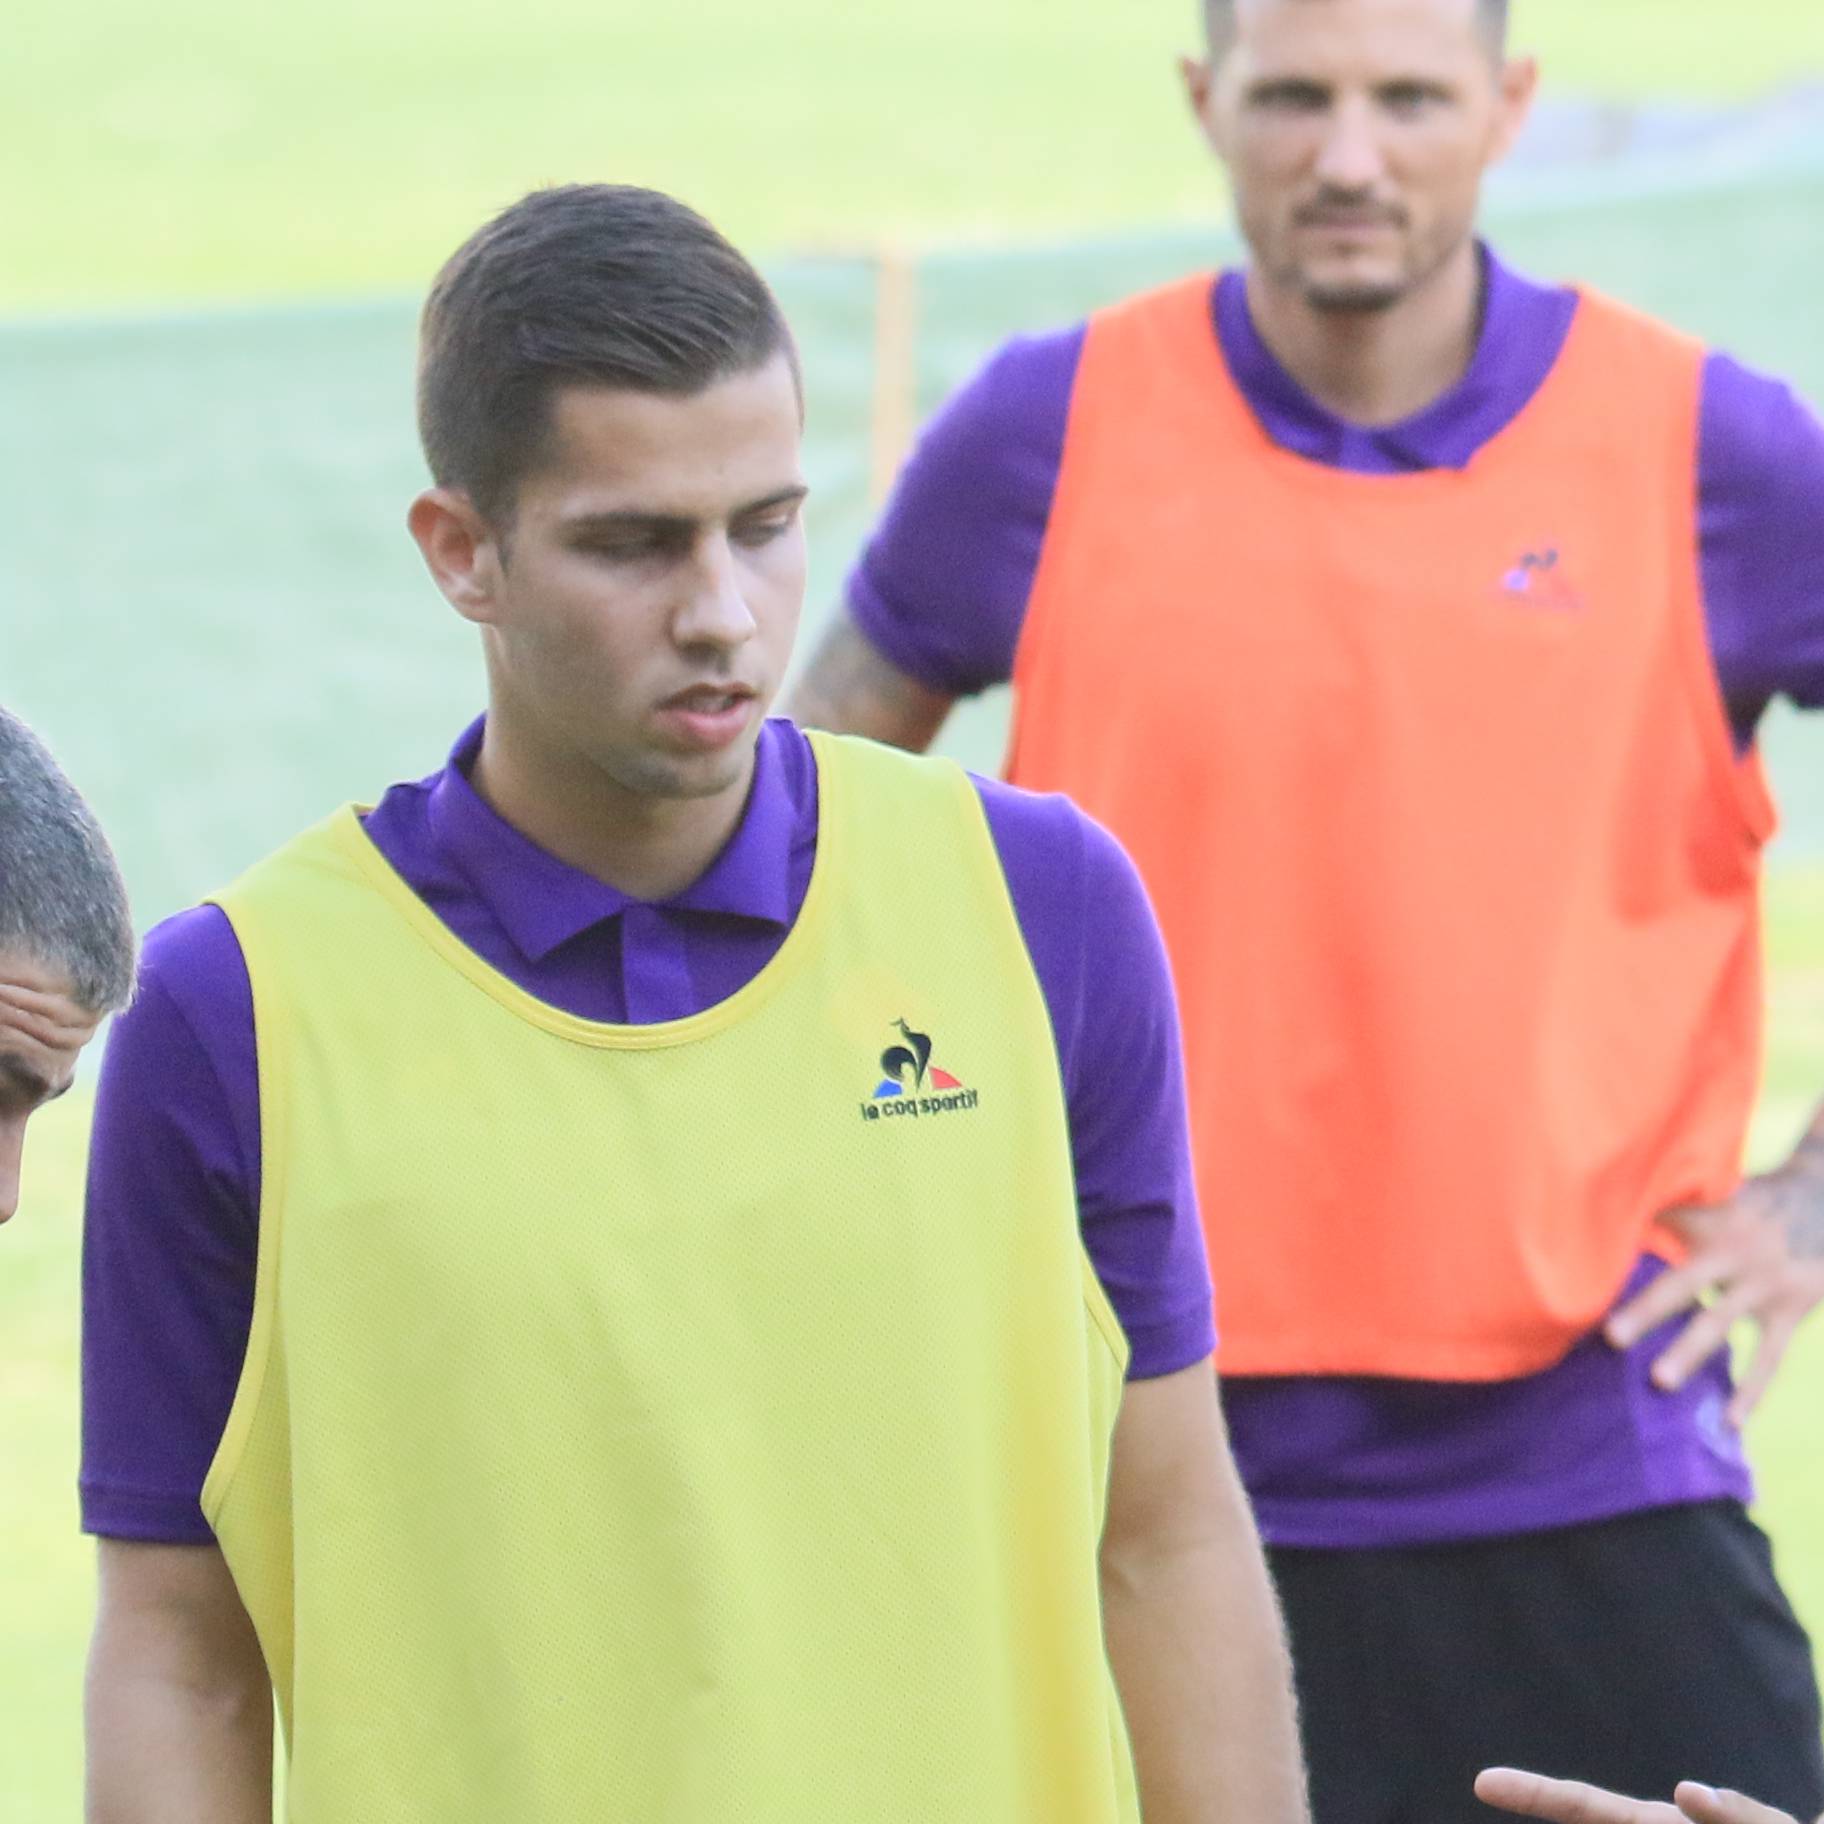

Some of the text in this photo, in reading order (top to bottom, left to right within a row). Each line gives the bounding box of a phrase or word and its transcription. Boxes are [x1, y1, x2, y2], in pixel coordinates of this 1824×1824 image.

[861, 1089, 978, 1120] le coq sportif
